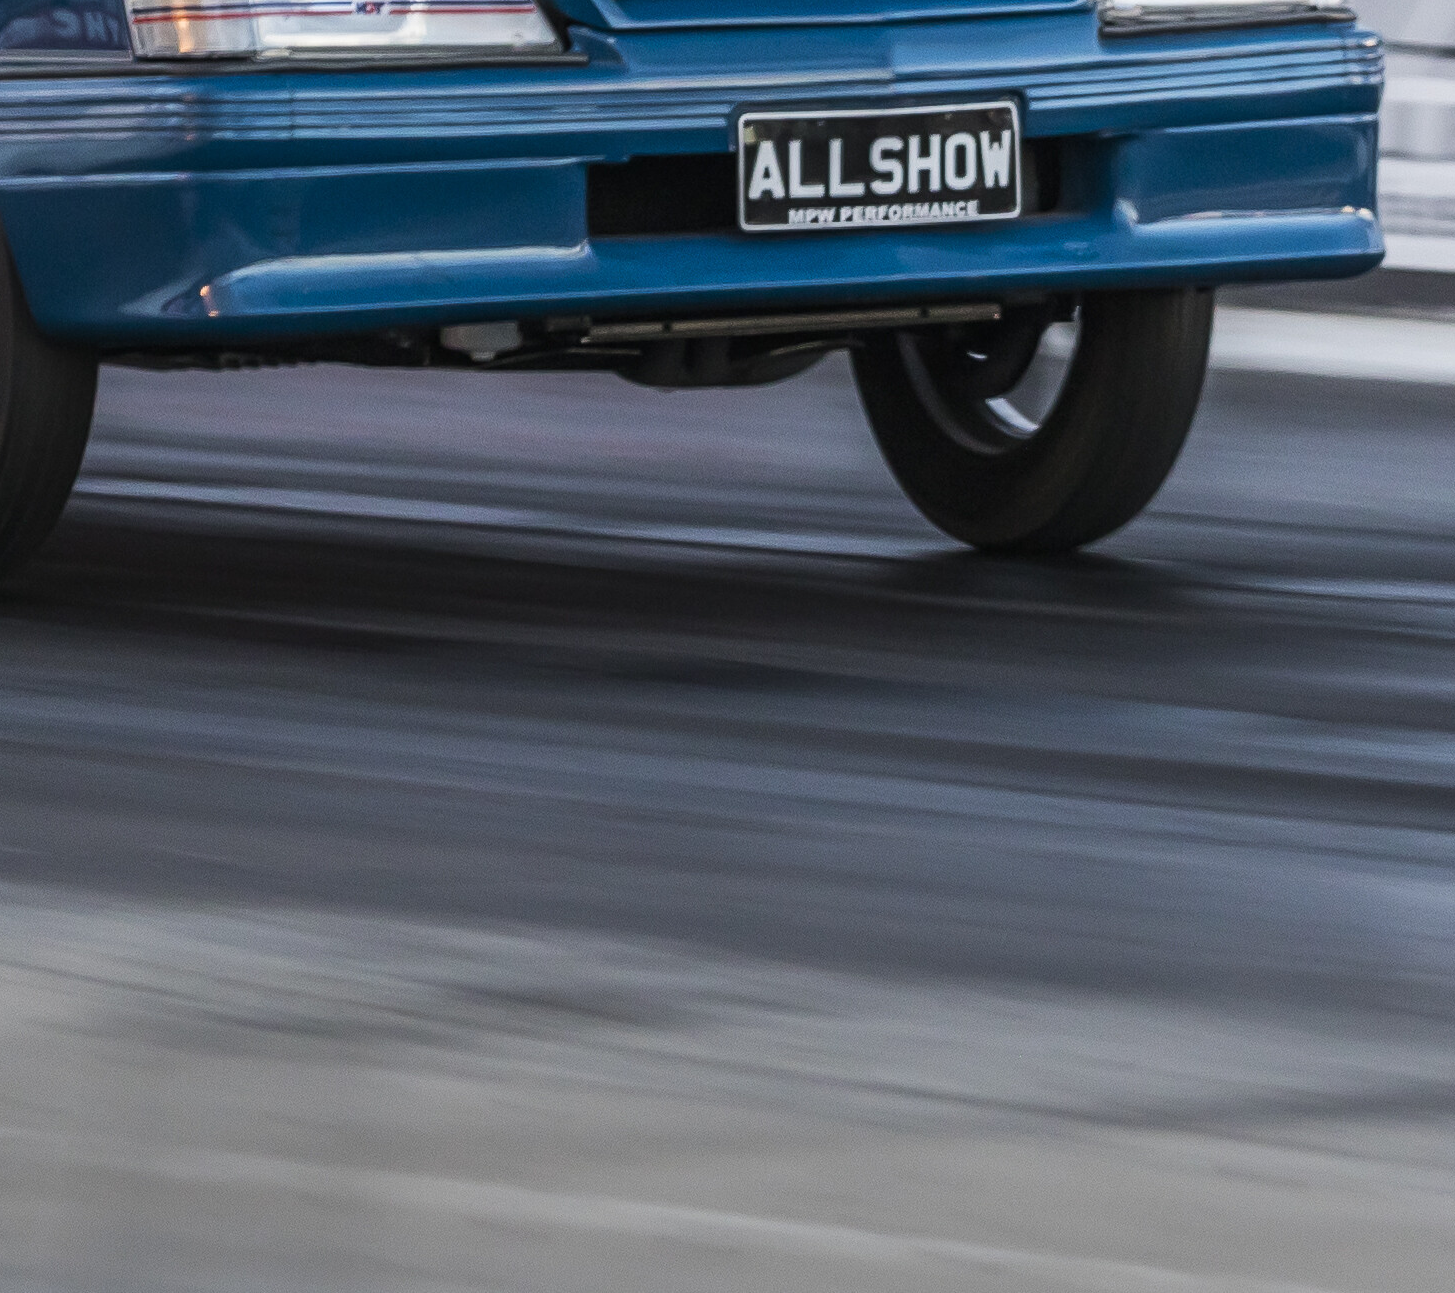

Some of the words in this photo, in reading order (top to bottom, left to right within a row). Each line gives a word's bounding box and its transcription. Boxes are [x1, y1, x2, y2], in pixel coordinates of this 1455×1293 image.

[747, 129, 1012, 201] ALLSHOW
[787, 207, 836, 225] MPW
[840, 199, 981, 222] PERFORMANCE
